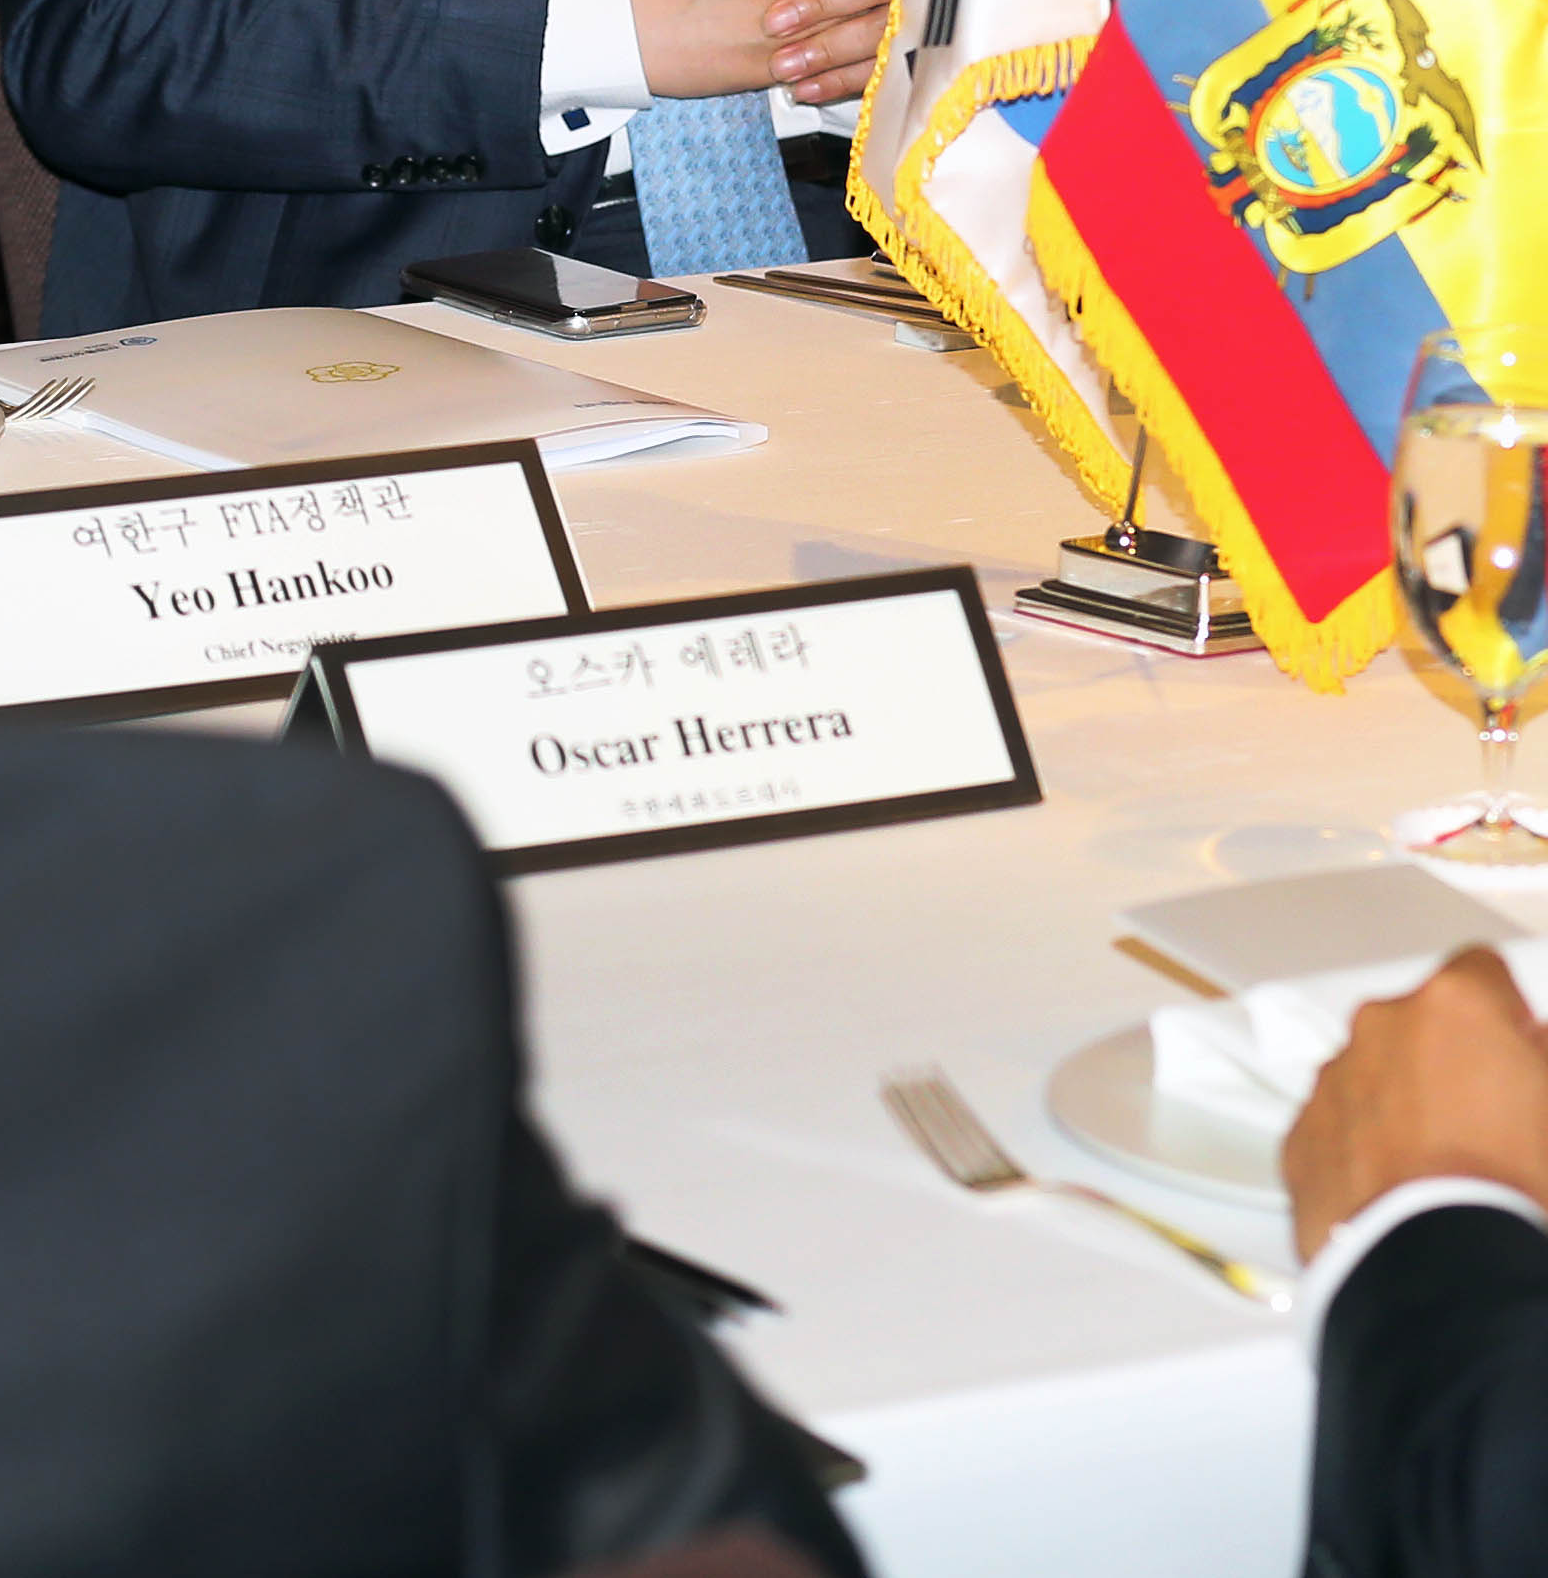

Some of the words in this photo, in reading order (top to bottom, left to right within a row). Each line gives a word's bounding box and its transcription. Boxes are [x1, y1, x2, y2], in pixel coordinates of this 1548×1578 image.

[72, 507, 198, 559] 여한구
[218, 478, 413, 539] FTA정책관
[130, 579, 216, 621] Yeo
[226, 559, 395, 609] Hankoo
[204, 640, 255, 663] Chief
[525, 640, 656, 699] 오스카
[678, 622, 811, 680] 에레라
[529, 731, 660, 778] Oscar
[673, 708, 854, 759] Herrera
